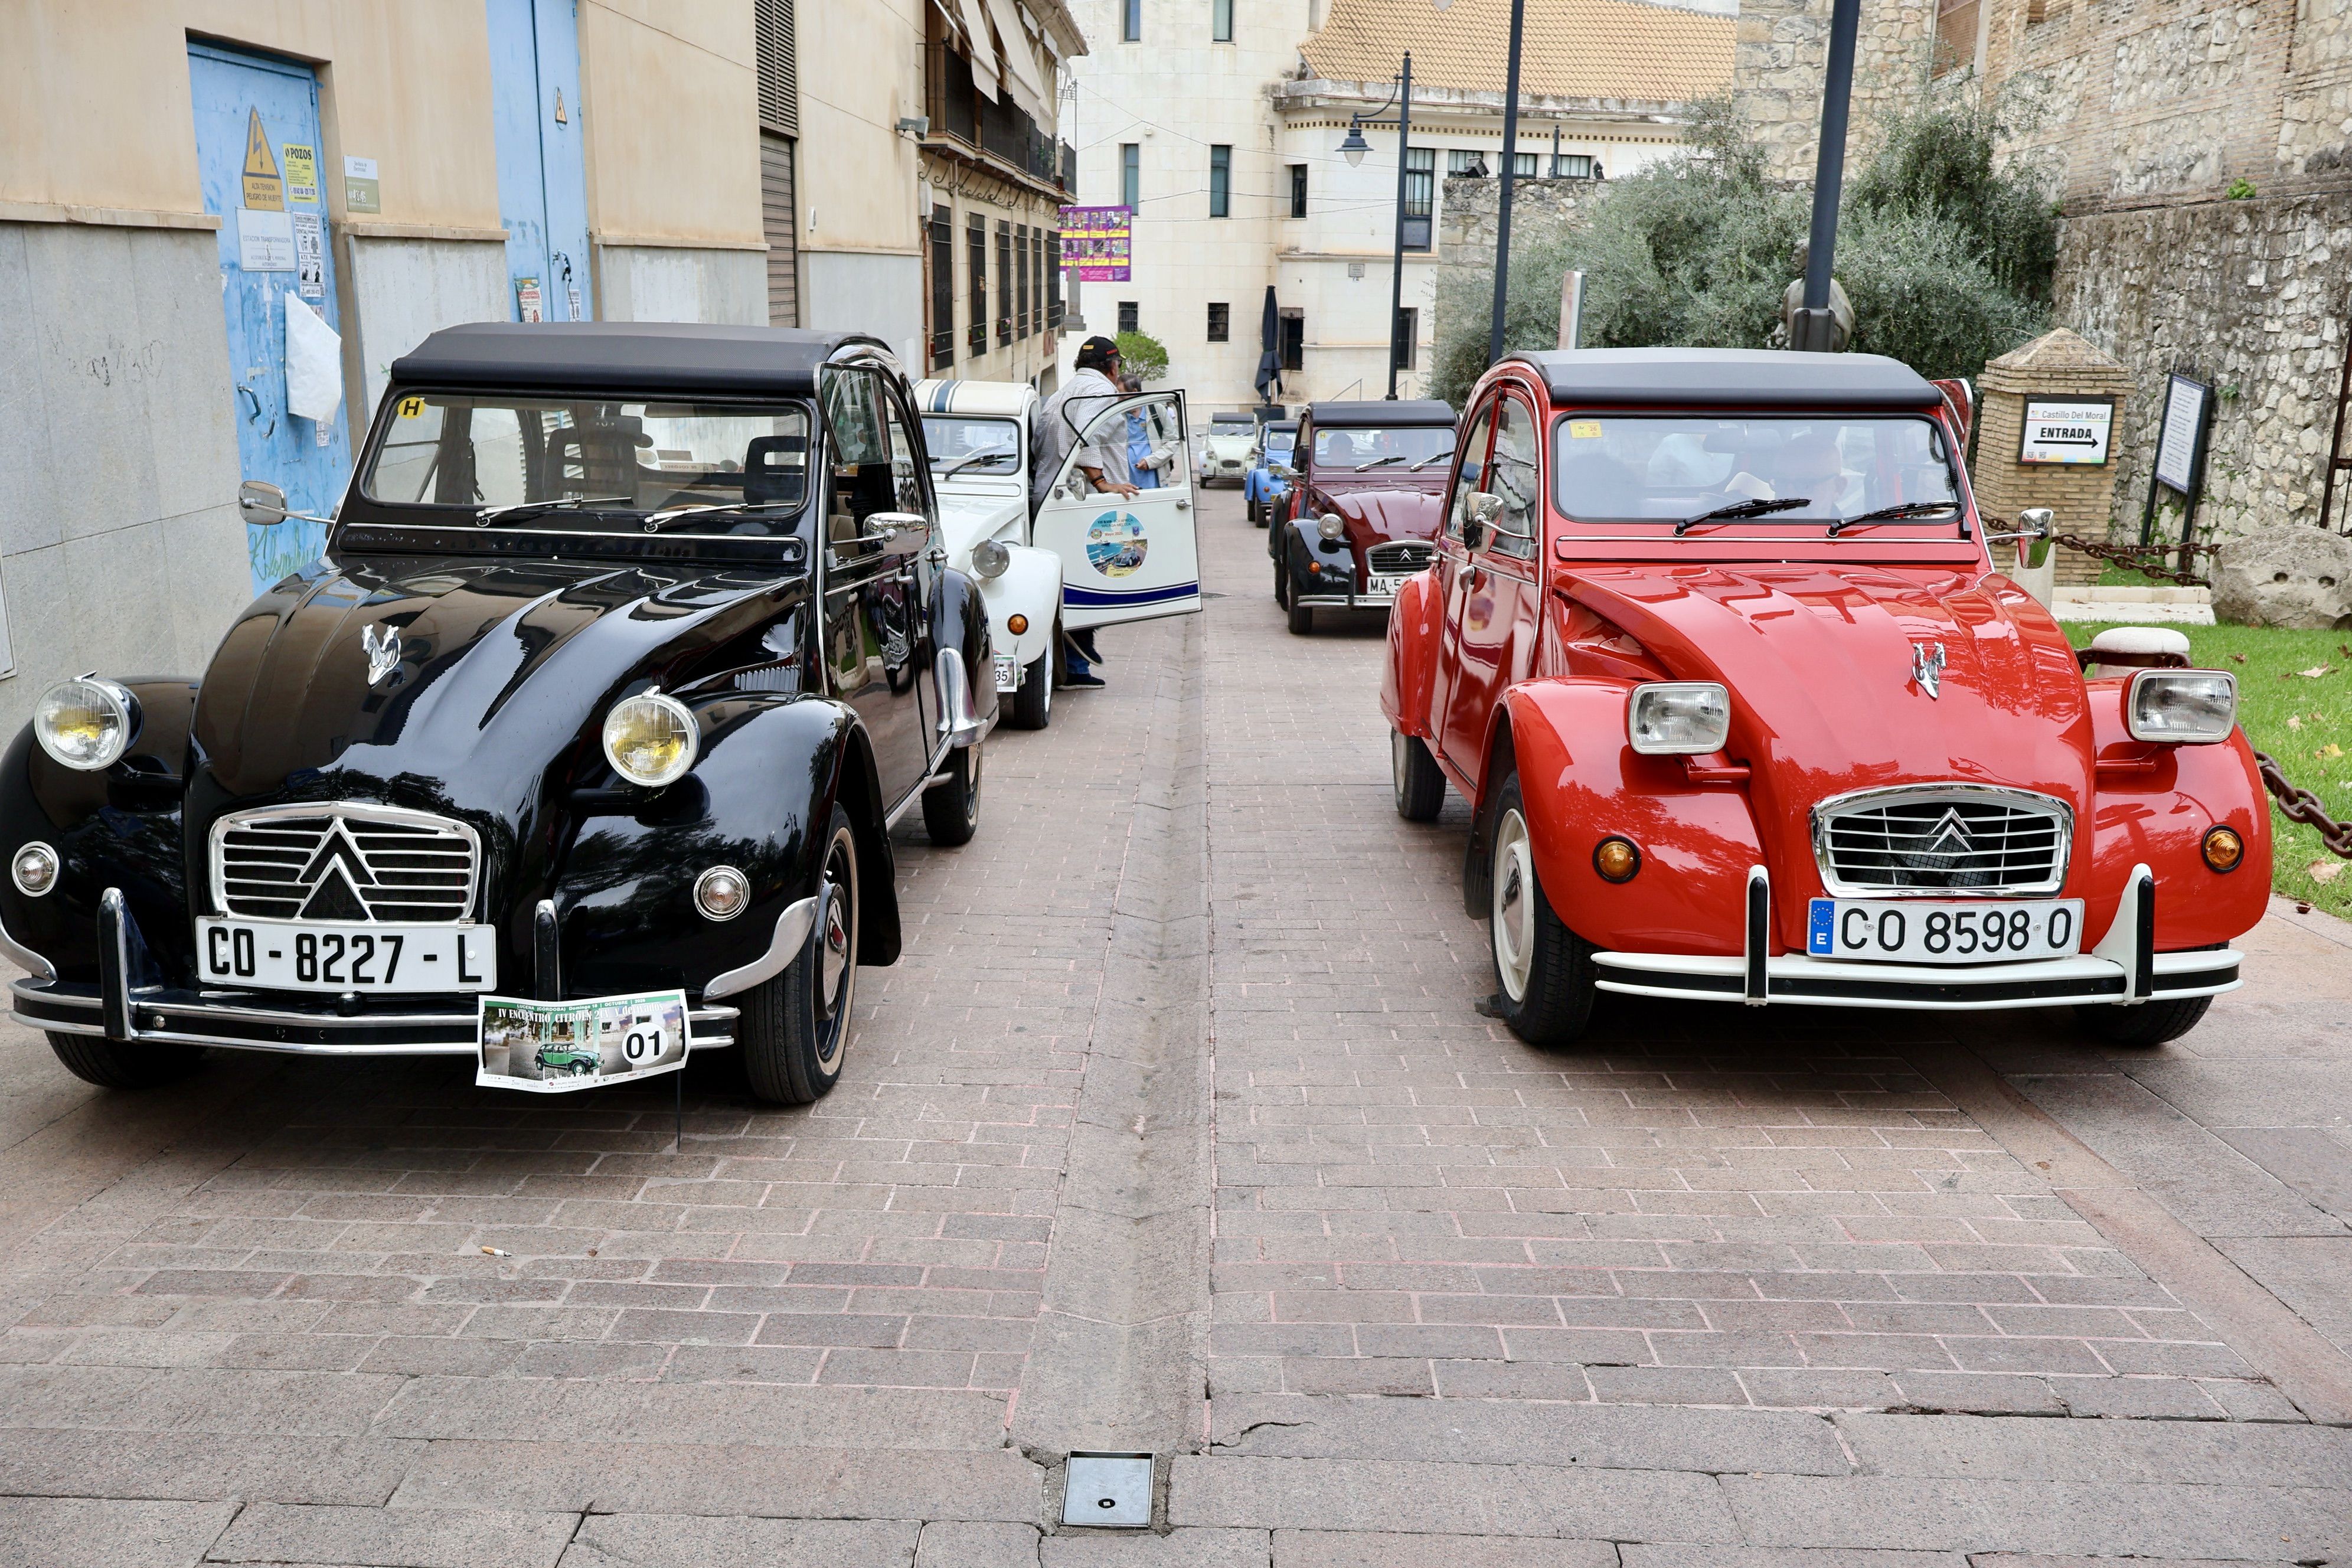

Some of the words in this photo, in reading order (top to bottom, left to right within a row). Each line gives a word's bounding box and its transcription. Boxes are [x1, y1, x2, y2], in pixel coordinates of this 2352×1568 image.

[290, 148, 312, 160] POZOS
[403, 400, 420, 416] H
[2042, 410, 2070, 419] Castillo
[2085, 411, 2106, 420] Moral
[2040, 427, 2092, 439] ENTRADA
[995, 671, 1008, 681] 35
[1841, 908, 1906, 952] CO
[1924, 909, 2030, 953] 8598
[1817, 933, 1827, 945] E
[208, 926, 256, 976] CO
[295, 933, 404, 983] 8227
[458, 934, 482, 982] L
[498, 1008, 507, 1018] IV
[509, 1009, 551, 1023] ENCUENTRO
[622, 1003, 664, 1015] derivados
[626, 1031, 660, 1059] 01
